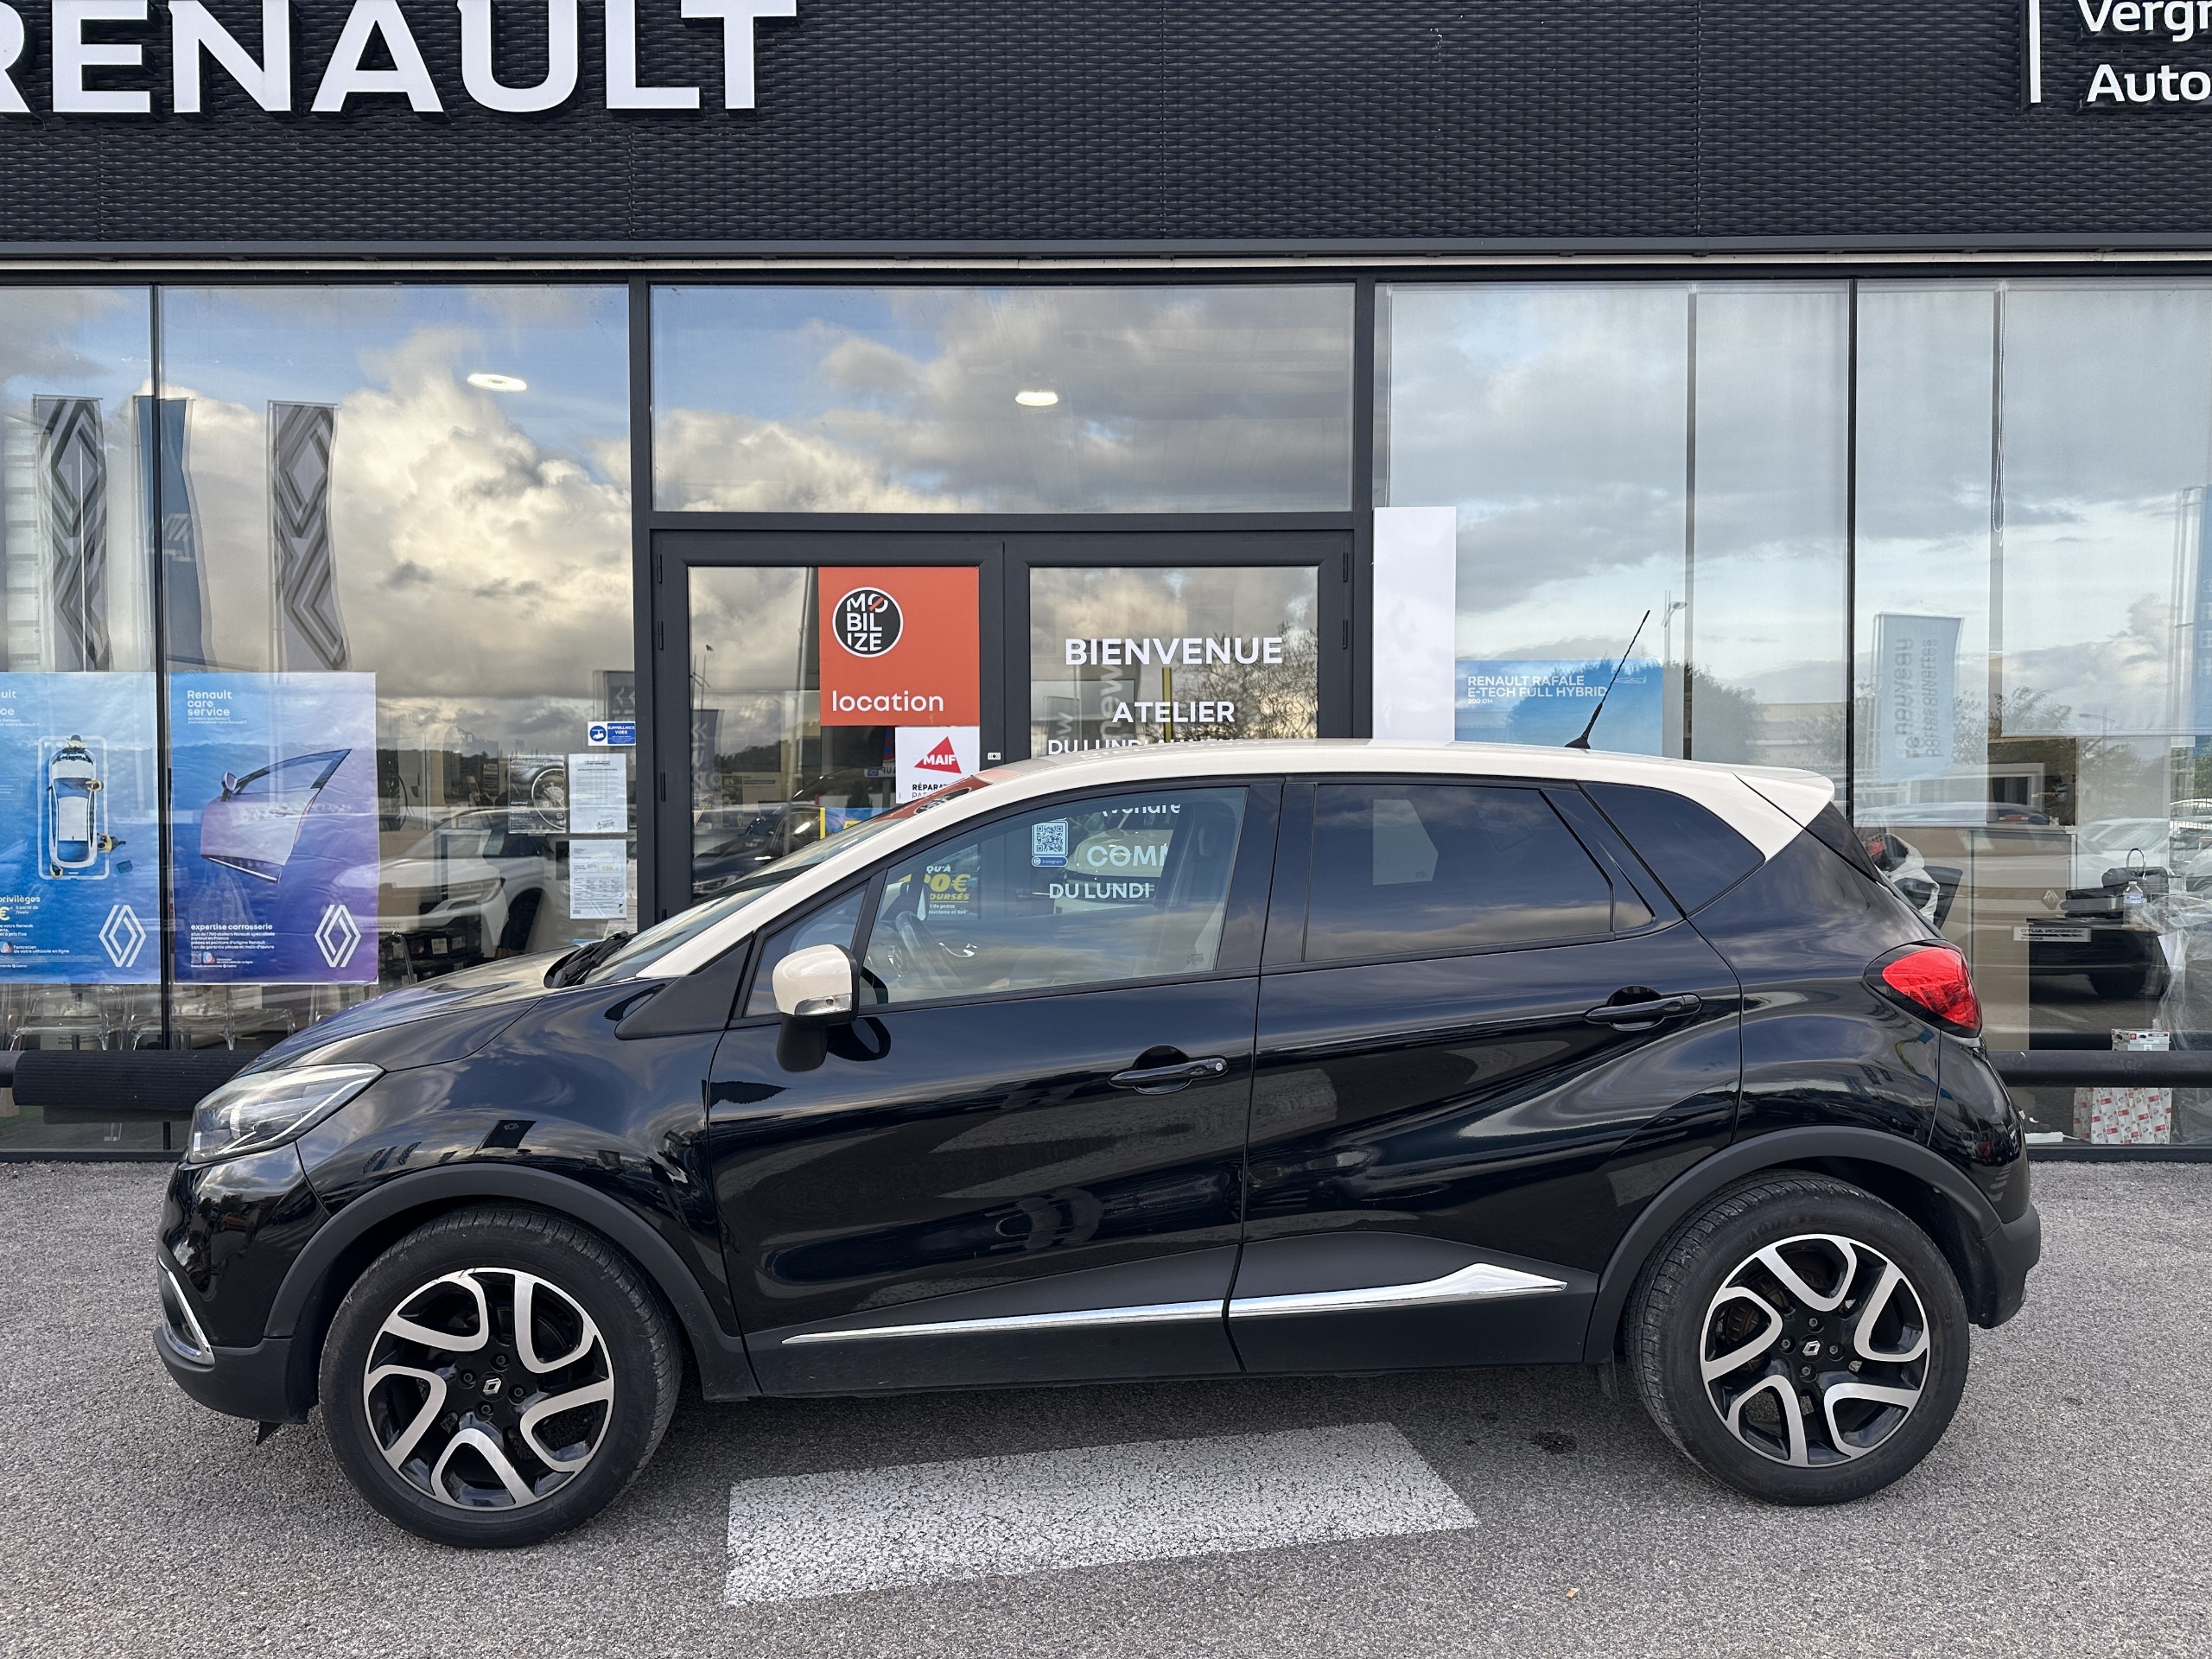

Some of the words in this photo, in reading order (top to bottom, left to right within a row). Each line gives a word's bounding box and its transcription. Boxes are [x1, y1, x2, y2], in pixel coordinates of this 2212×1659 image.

[0, 0, 797, 113] ENAULT
[2087, 64, 2212, 102] Auto
[1065, 638, 1283, 664] BIENVENUE
[1467, 676, 1530, 686] RENAULT
[1533, 675, 1585, 686] RAFALE
[188, 690, 232, 699] Renault
[1467, 687, 1517, 697] E-TECH
[1519, 687, 1553, 697] FULL
[1556, 686, 1608, 697] HYBRID
[832, 690, 944, 712] location
[188, 707, 230, 716] service
[1111, 702, 1236, 723] ATELIER
[923, 754, 957, 766] MAIF
[1049, 883, 1079, 899] DU
[1084, 883, 1150, 899] LUNDI
